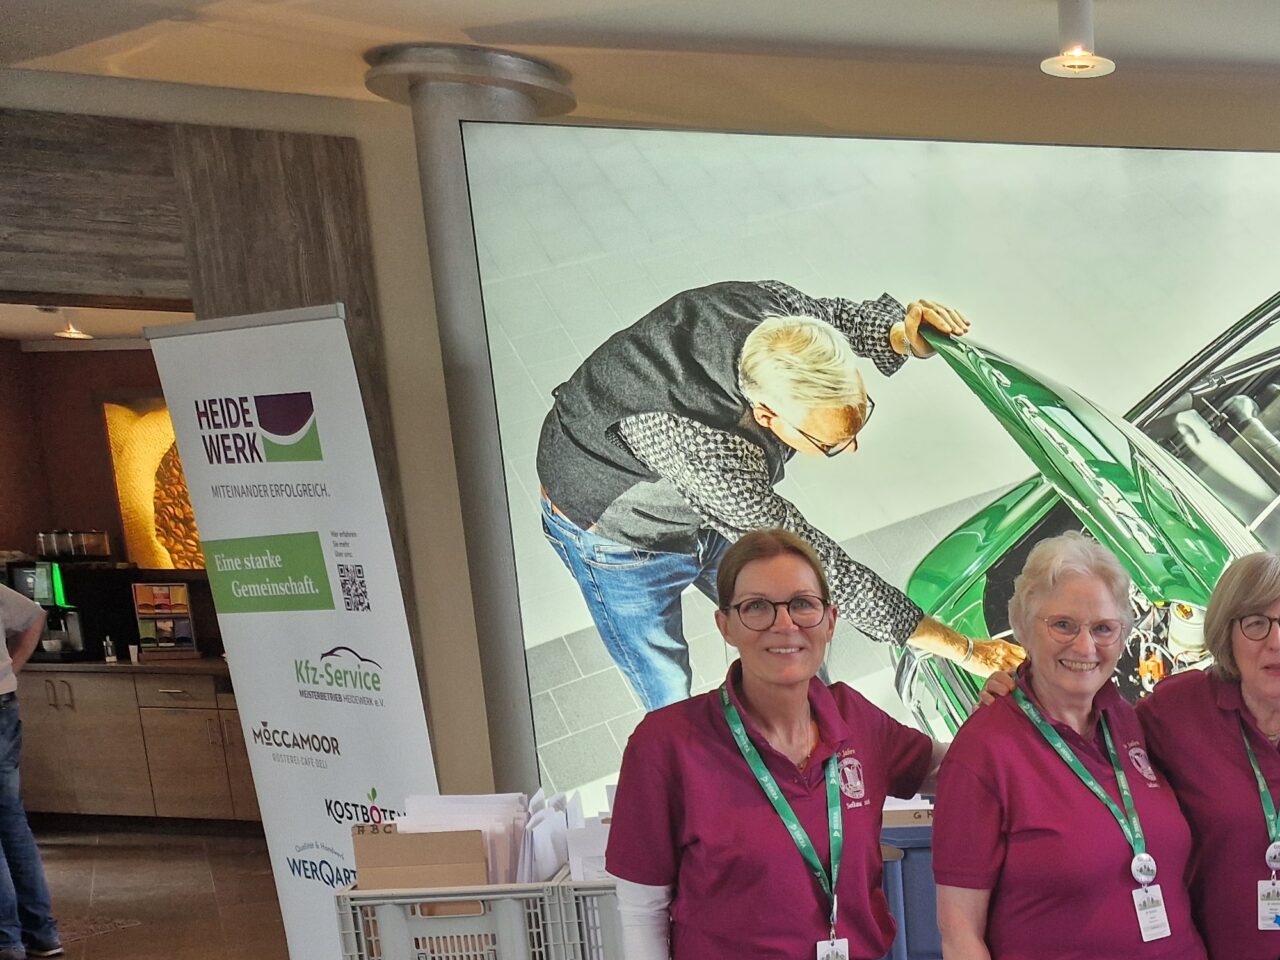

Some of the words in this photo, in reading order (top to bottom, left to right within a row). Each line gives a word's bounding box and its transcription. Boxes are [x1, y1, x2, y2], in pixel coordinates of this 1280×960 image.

[195, 397, 253, 430] HEIDE
[202, 432, 263, 464] WERK
[211, 484, 268, 498] MITEINANDER
[270, 483, 331, 498] ERFOLGREICH.
[215, 553, 242, 571] Eine
[244, 550, 283, 570] starke
[231, 575, 319, 598] Gemeinschaft.
[294, 659, 381, 691] Kfz-Service
[325, 798, 407, 824] KOSTBOTE
